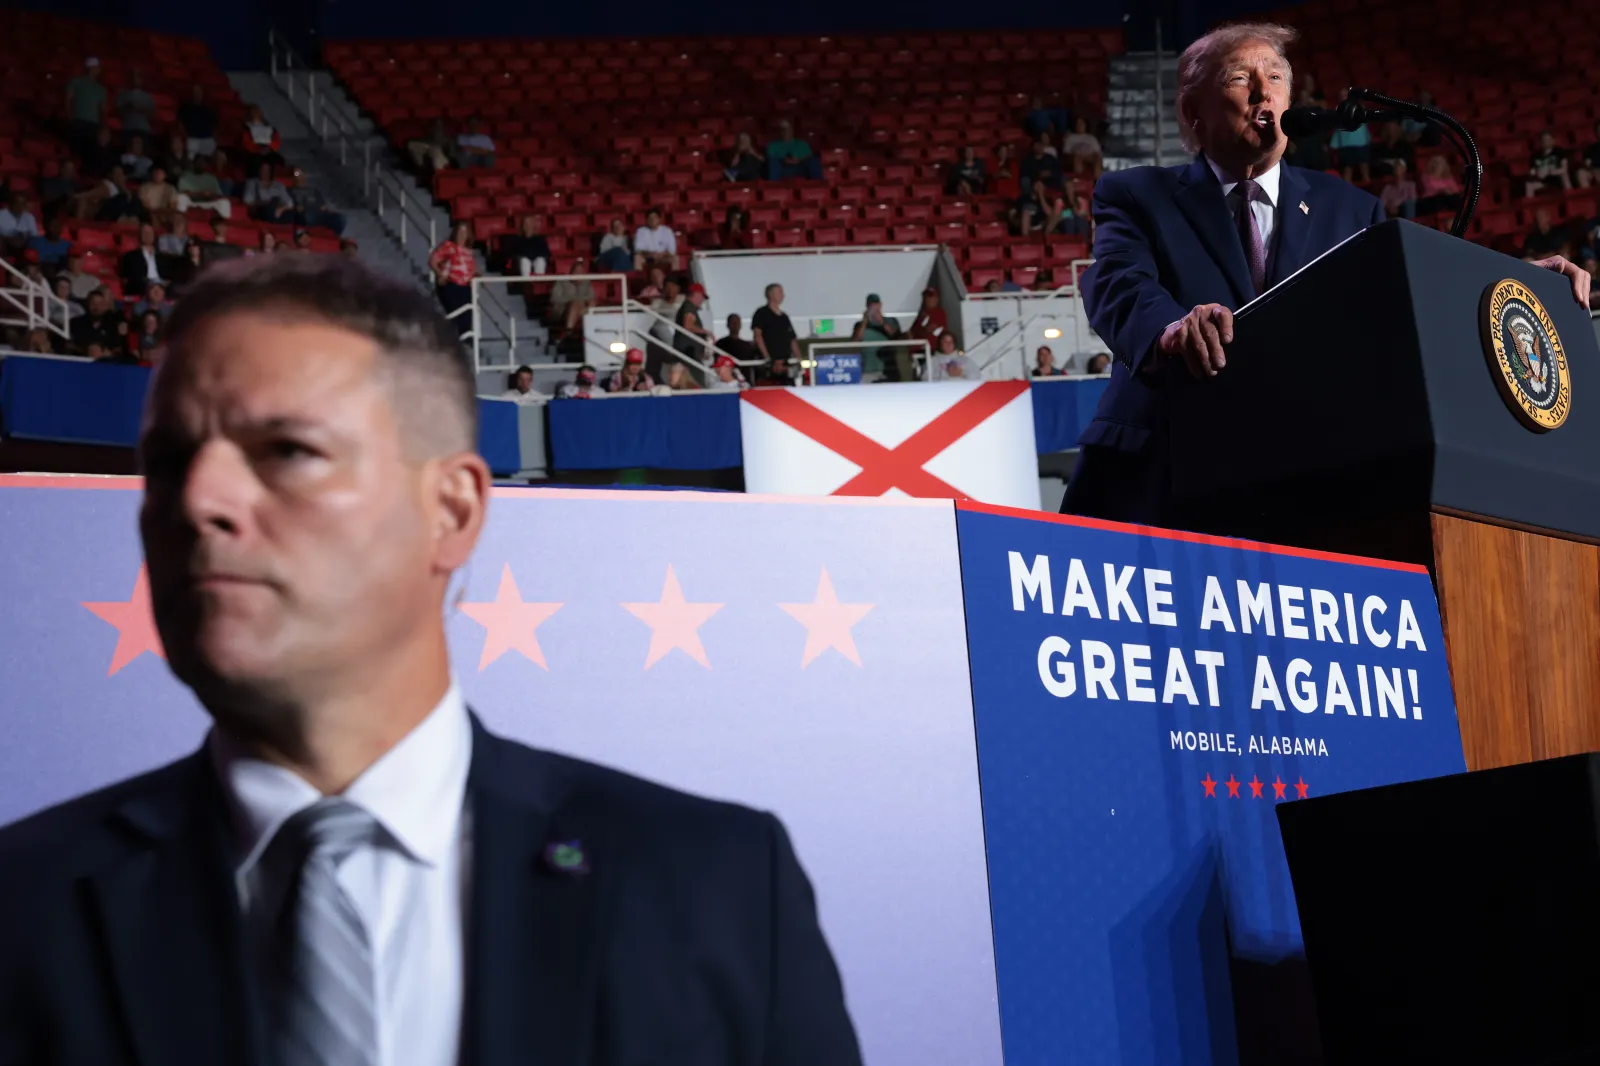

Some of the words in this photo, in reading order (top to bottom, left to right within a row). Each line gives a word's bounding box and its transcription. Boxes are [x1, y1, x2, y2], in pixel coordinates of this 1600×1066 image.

[1492, 284, 1515, 342] PRESIDENT
[1497, 347, 1507, 367] THE
[1539, 309, 1566, 370] UNITED
[827, 372, 852, 383] TIPS
[836, 358, 859, 368] TAX
[1515, 384, 1538, 418] SEAL
[1549, 383, 1568, 423] STATES
[1007, 550, 1178, 627] MAKE
[1199, 575, 1428, 652] AMERICA
[1037, 635, 1227, 708] GREAT
[1250, 654, 1423, 721] AGAIN!
[1170, 730, 1242, 756] MOBILE,
[1248, 734, 1329, 757] ALABAMA
